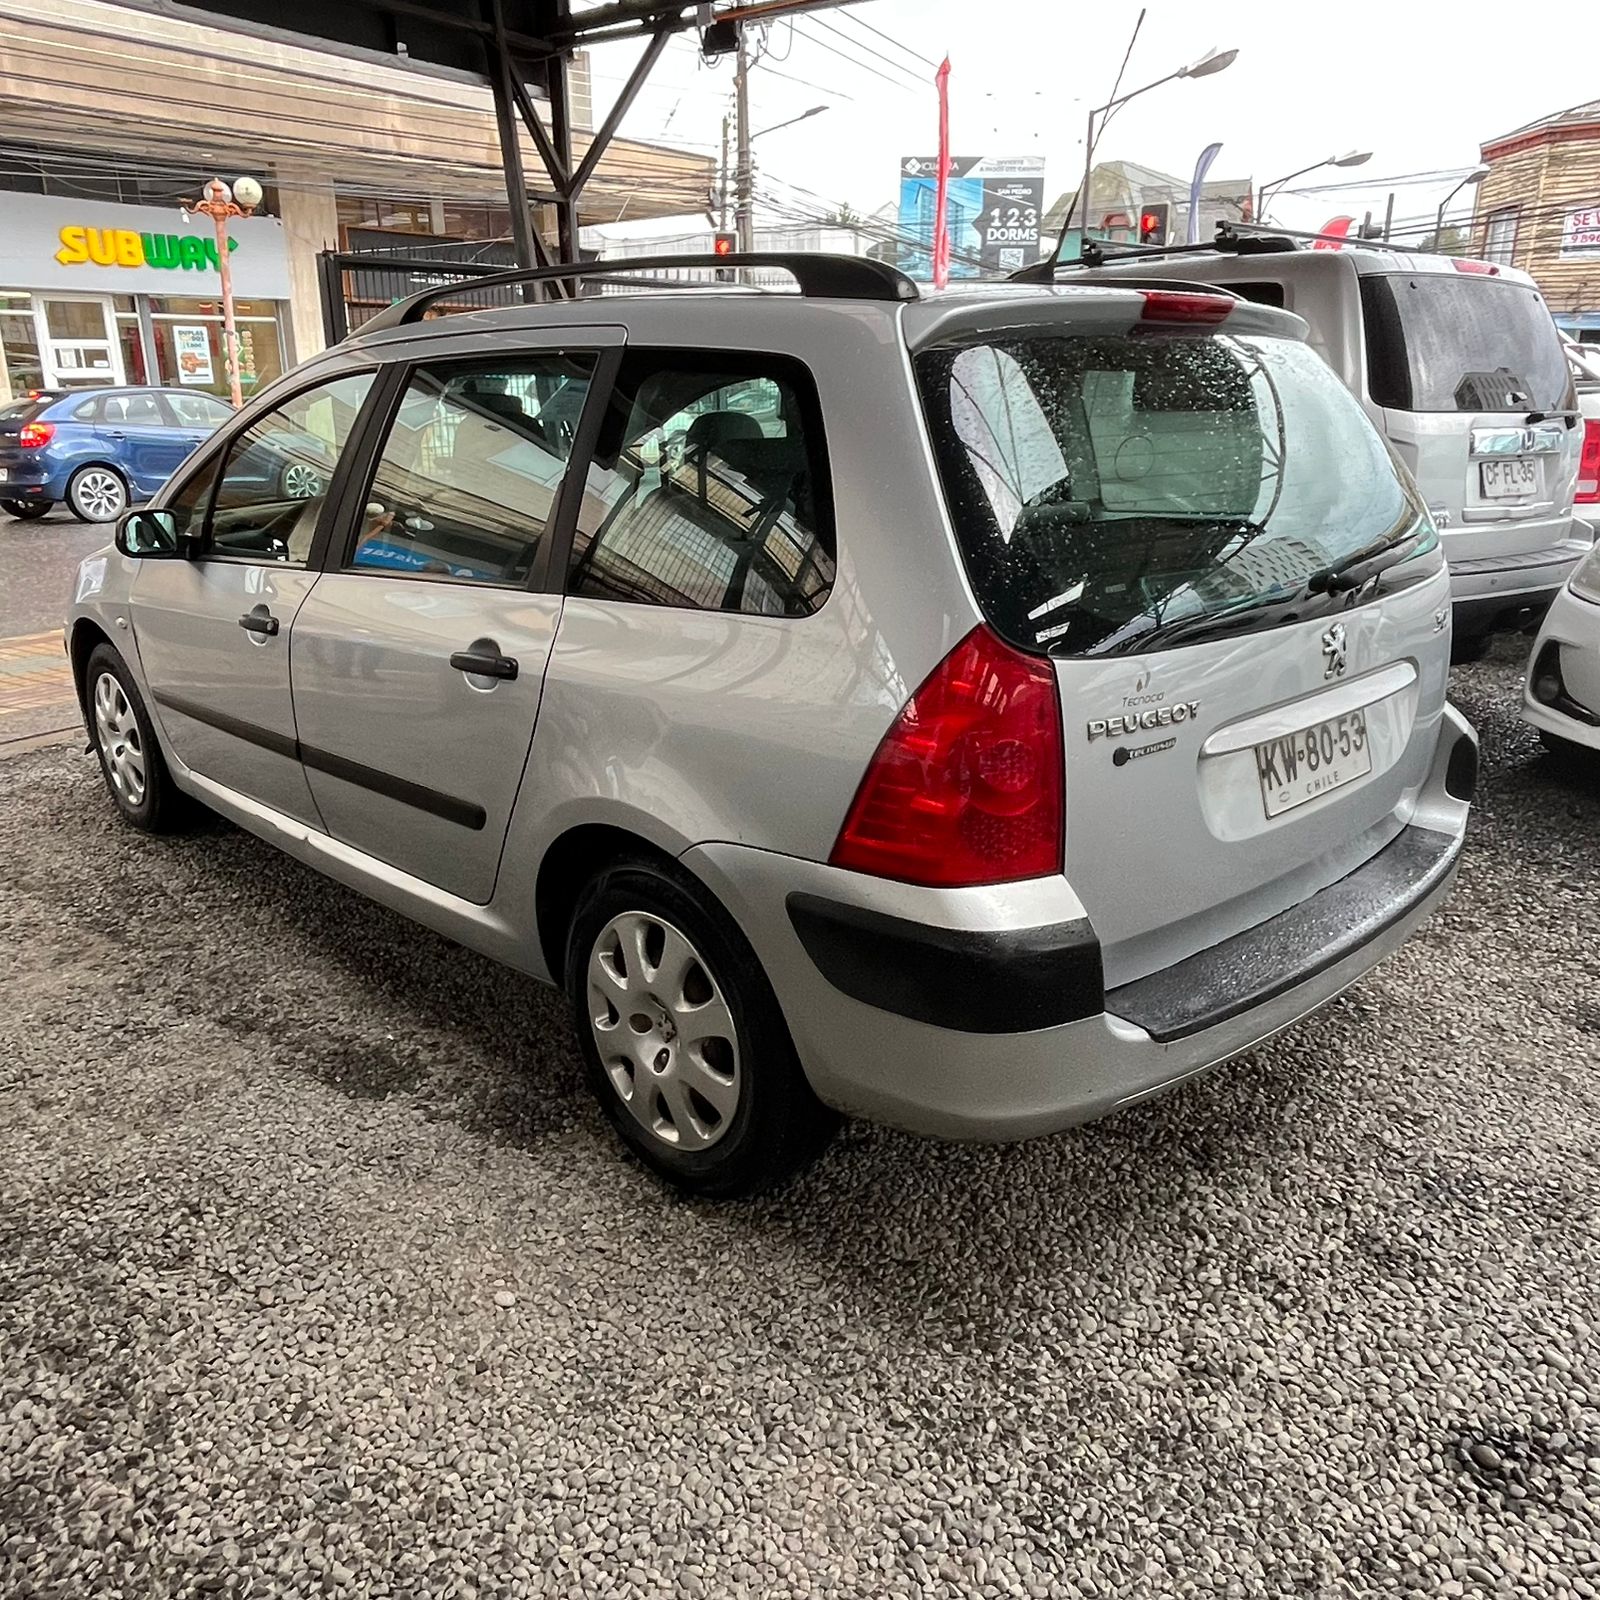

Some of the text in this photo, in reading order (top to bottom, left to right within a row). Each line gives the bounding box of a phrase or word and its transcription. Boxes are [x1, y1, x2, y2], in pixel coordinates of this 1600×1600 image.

[1572, 212, 1590, 226] SE
[986, 228, 1038, 241] DORMS
[54, 226, 239, 272] SUBWAY
[1087, 699, 1202, 742] PEUGEOT
[1306, 770, 1340, 794] CHILE
